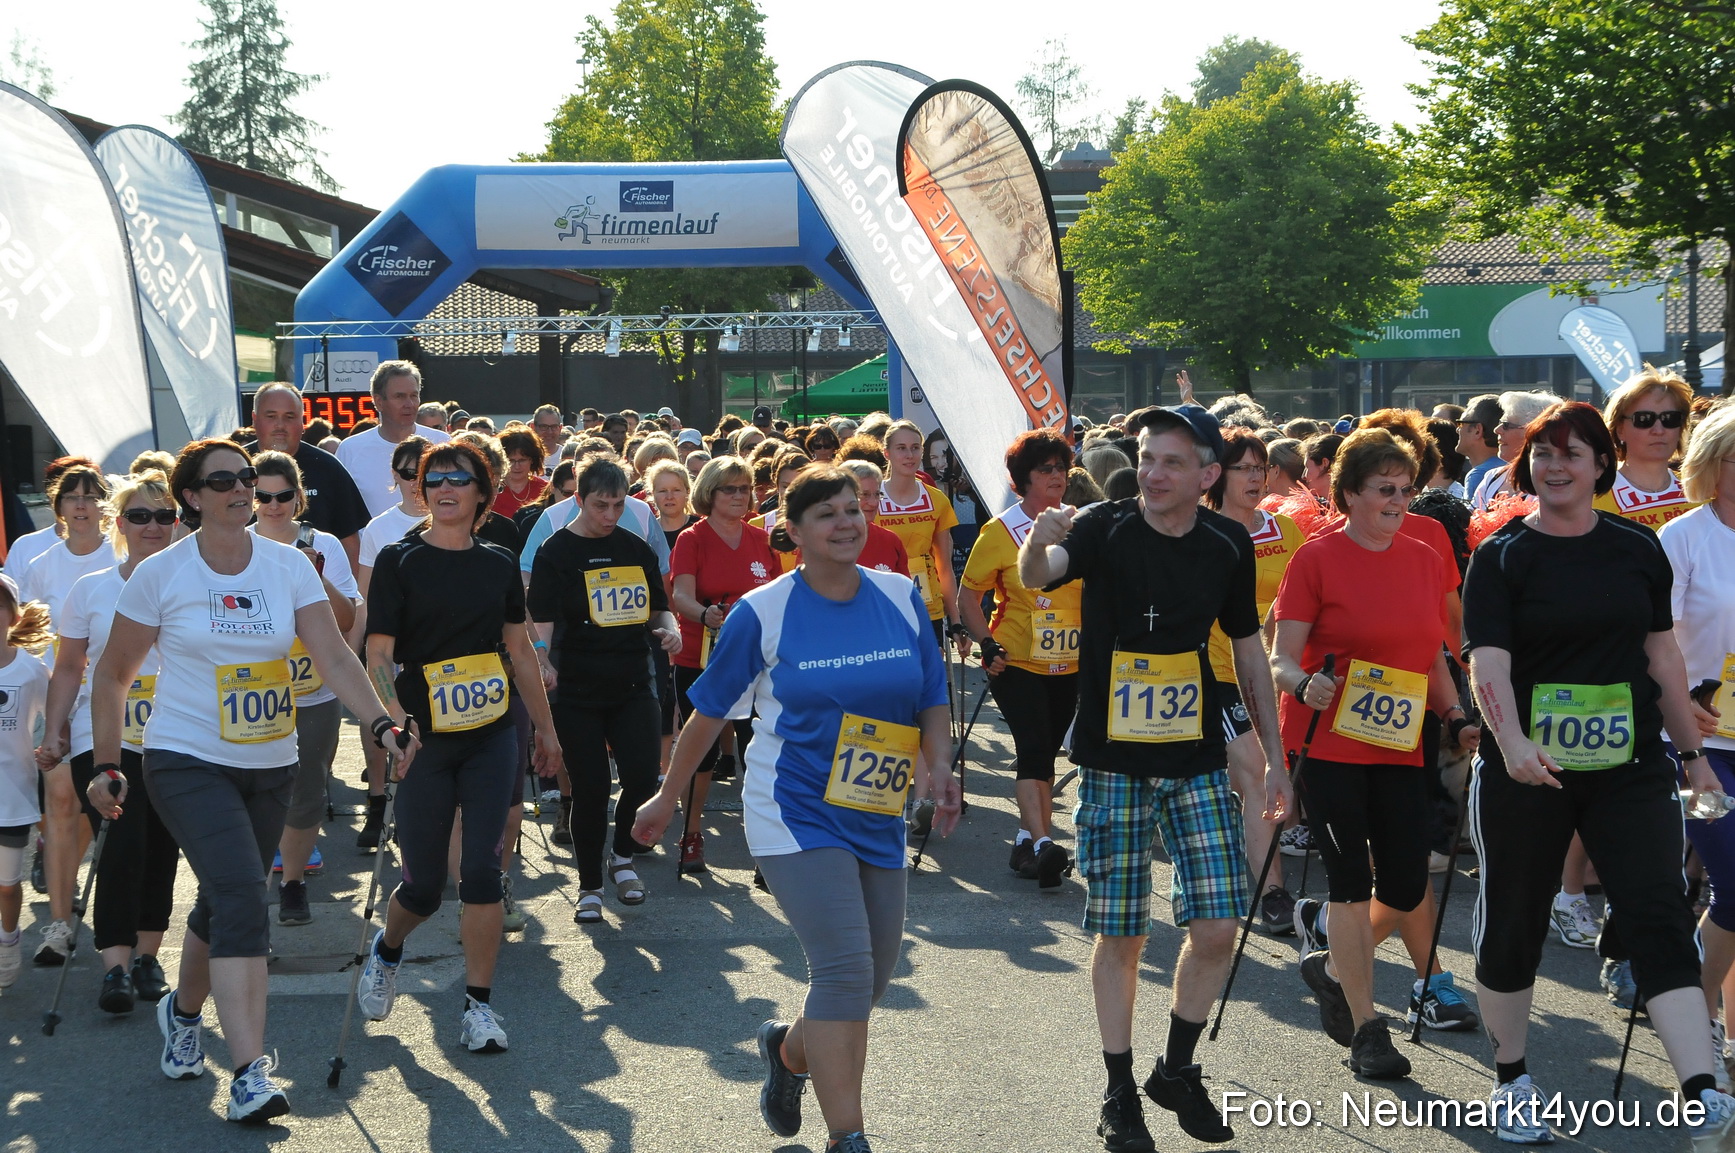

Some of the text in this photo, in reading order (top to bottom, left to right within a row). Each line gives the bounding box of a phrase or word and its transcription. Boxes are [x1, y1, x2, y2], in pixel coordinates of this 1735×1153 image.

[631, 192, 670, 201] Fischer
[602, 212, 720, 235] firmenlauf
[601, 236, 650, 244] neumarkt
[371, 256, 435, 269] Fischer
[880, 514, 937, 527] MAX BÖGL
[1255, 545, 1288, 559] BÖGL
[591, 585, 647, 612] 1126
[211, 621, 274, 631] POLGER
[1040, 628, 1081, 651] 810
[798, 647, 911, 670] energiegeladen
[223, 687, 293, 724] 1004
[433, 678, 505, 715] 1083
[1114, 683, 1199, 720] 1132
[1350, 691, 1412, 730] 493
[1535, 715, 1630, 750] 1085
[838, 748, 911, 793] 1256
